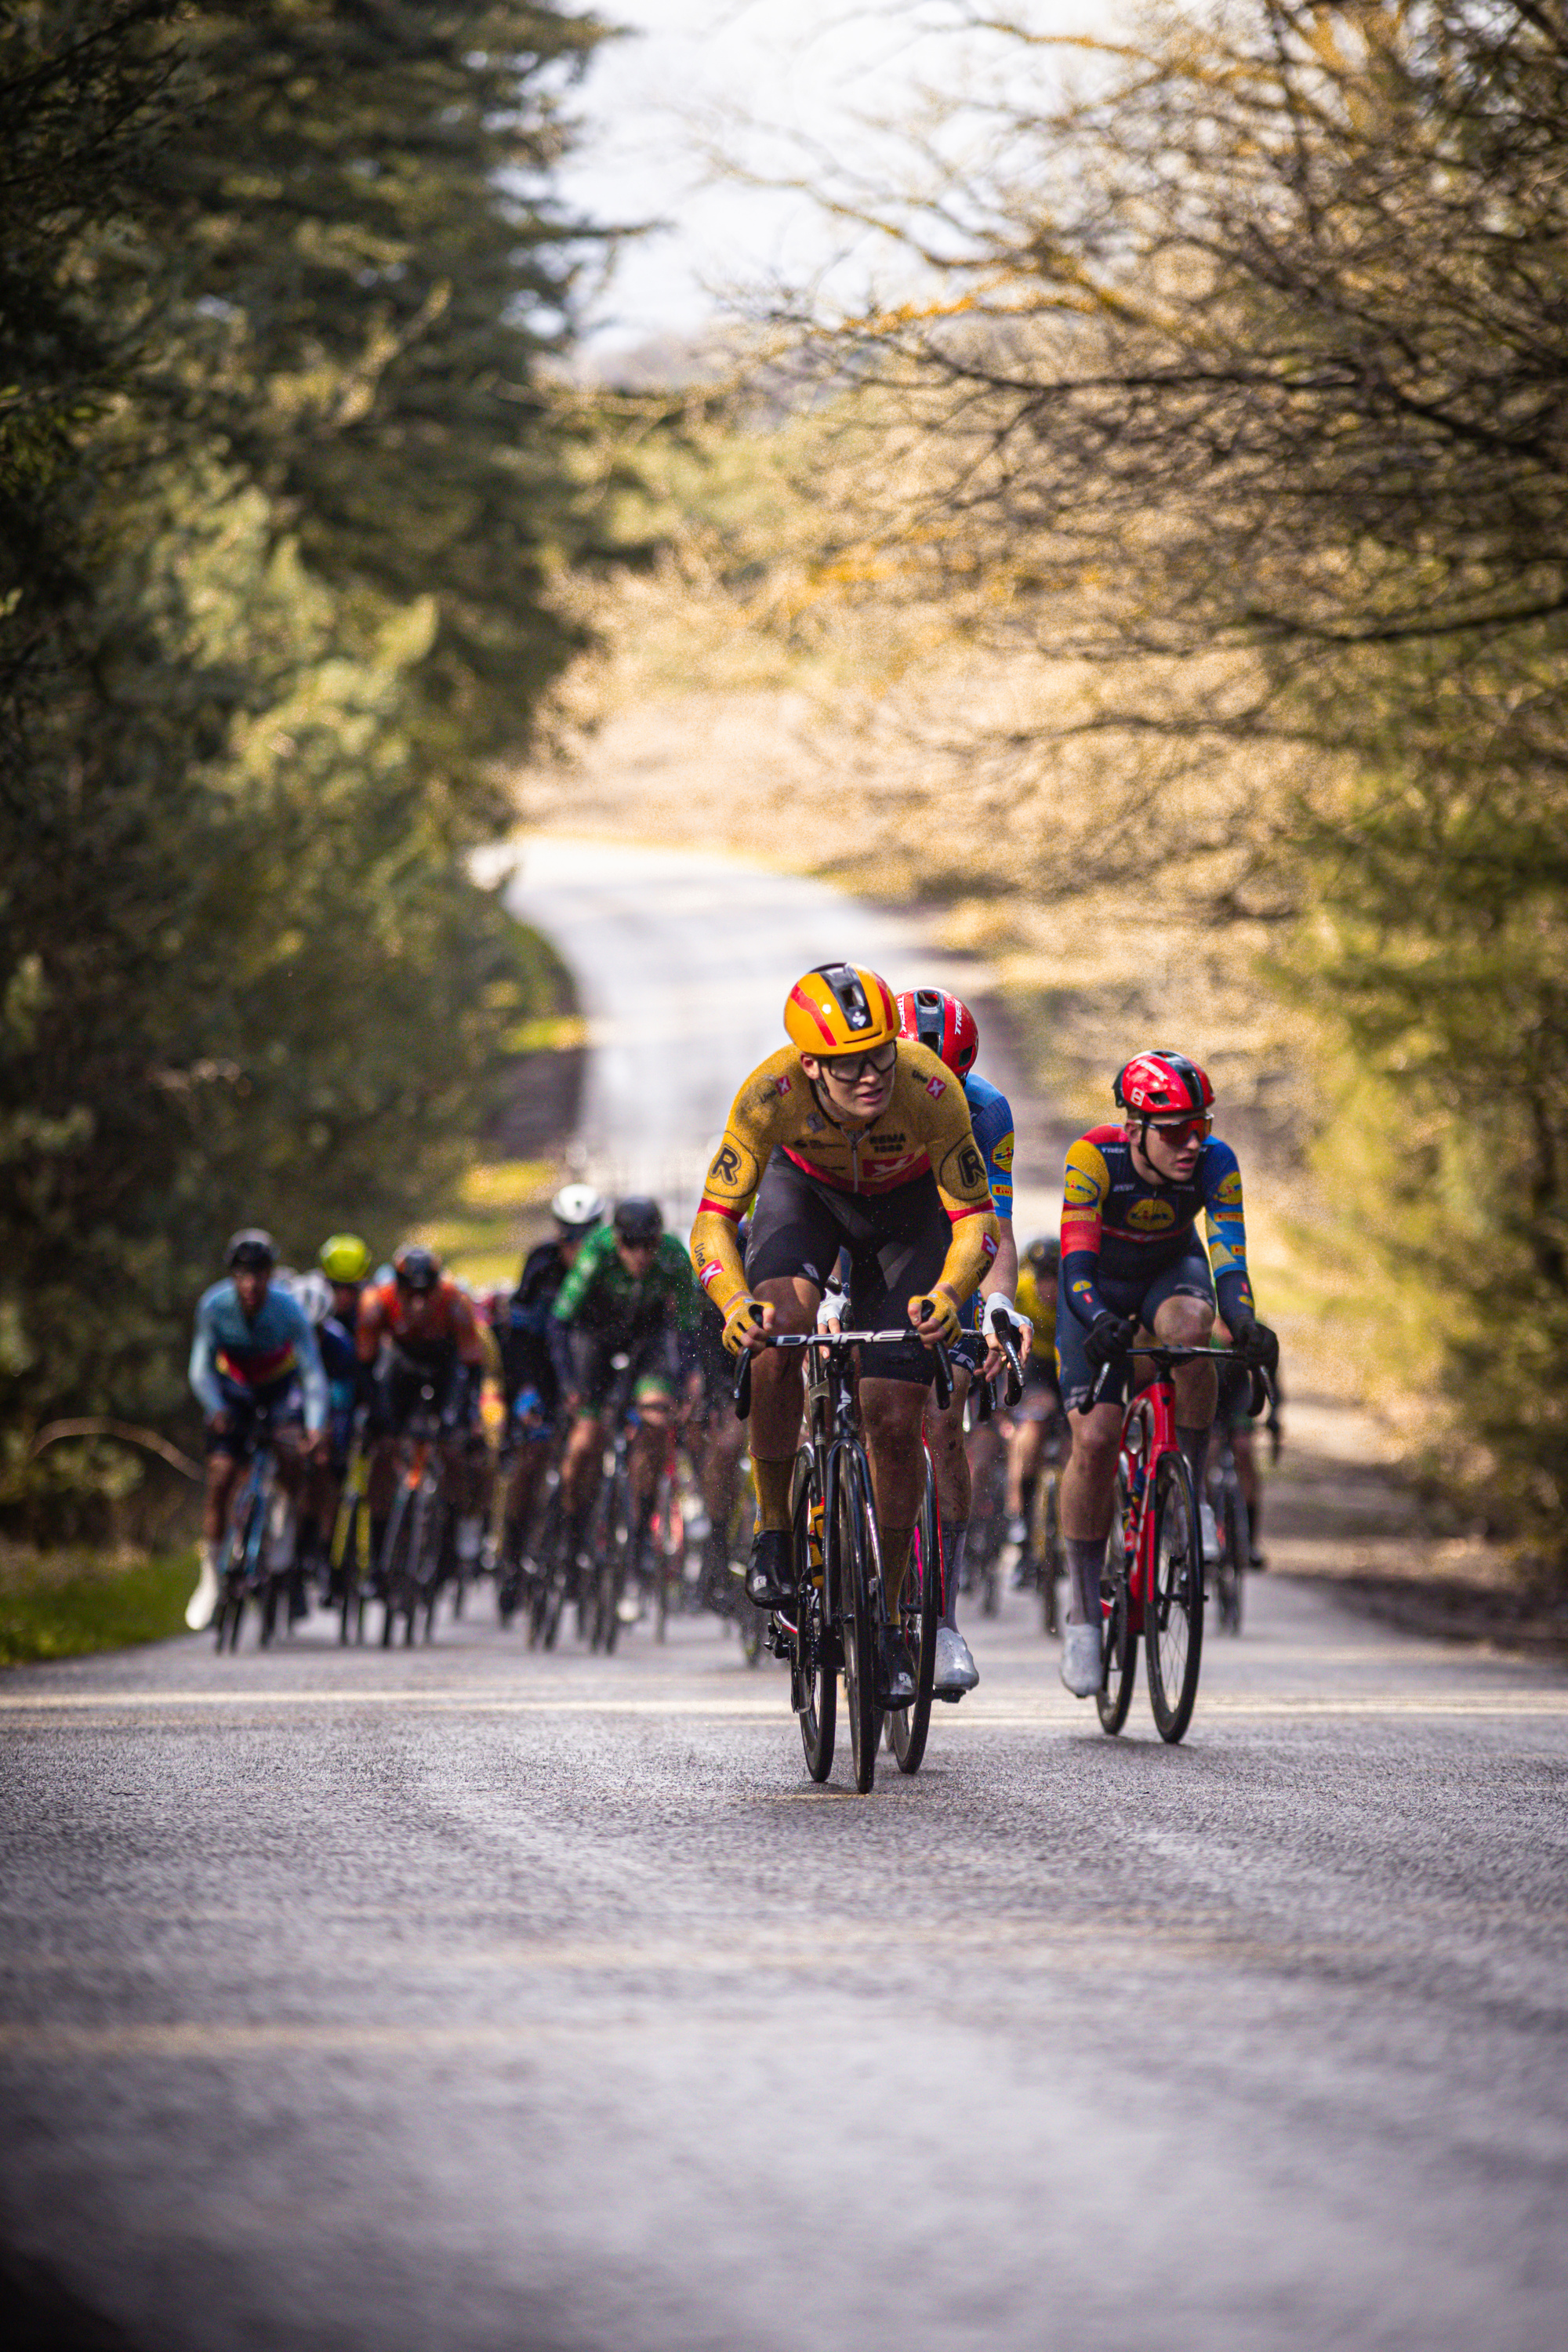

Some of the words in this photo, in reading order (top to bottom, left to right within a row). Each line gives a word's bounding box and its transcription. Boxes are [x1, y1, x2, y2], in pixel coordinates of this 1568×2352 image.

[912, 1069, 928, 1083] Uno
[711, 1145, 739, 1183] R
[960, 1147, 986, 1185] R
[694, 1243, 706, 1268] Uno
[776, 1330, 906, 1347] DARE
